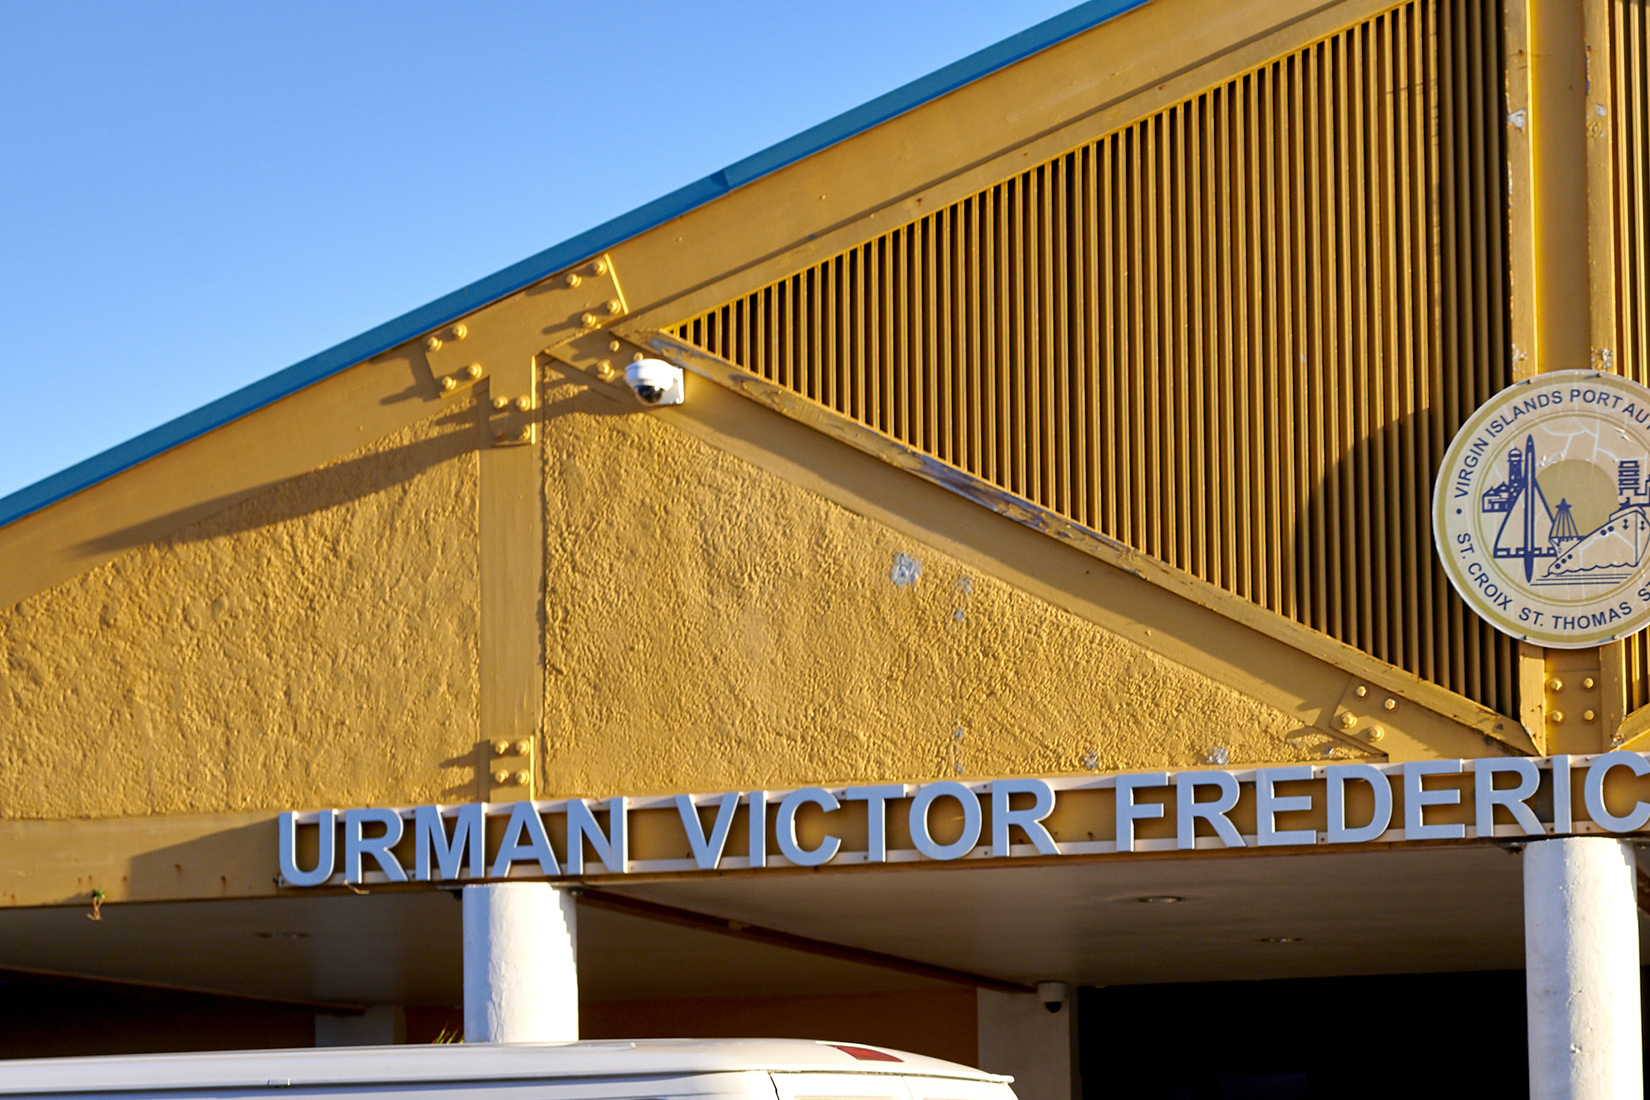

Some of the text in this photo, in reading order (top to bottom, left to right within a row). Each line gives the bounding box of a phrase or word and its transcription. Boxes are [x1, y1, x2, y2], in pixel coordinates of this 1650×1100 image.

[1454, 436, 1489, 500] VIRGIN
[1490, 389, 1564, 439] ISLANDS
[1569, 388, 1623, 410] PORT
[1456, 531, 1472, 560] ST.
[1467, 561, 1514, 612] CROIX
[1518, 606, 1546, 628] ST.
[1551, 601, 1634, 631] THOMAS
[278, 796, 628, 886] URMAN
[675, 779, 1062, 870] VICTOR
